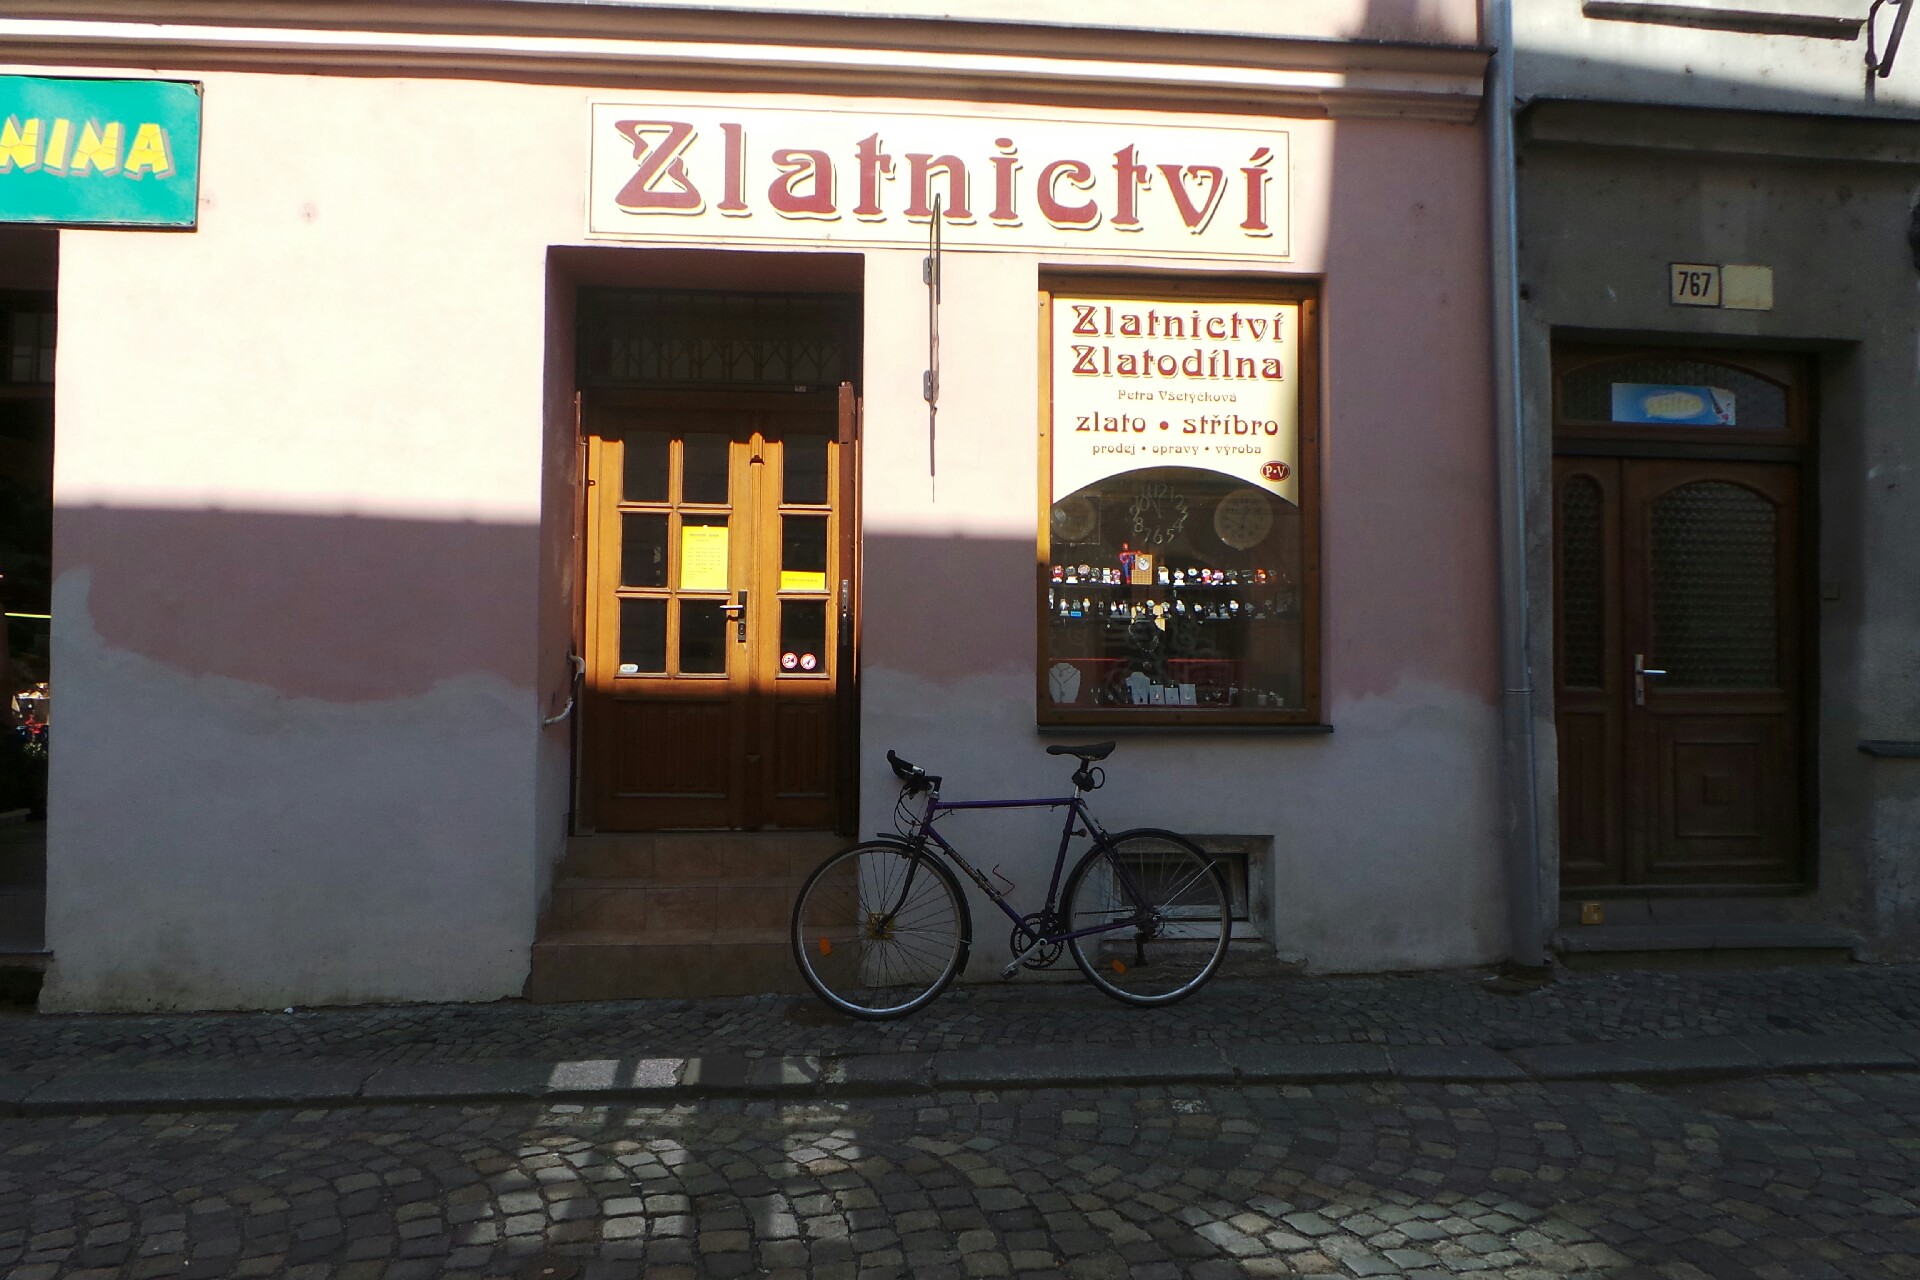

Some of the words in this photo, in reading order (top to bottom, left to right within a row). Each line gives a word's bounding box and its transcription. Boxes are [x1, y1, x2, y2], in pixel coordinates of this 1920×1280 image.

[0, 113, 176, 181] NINA
[614, 119, 1273, 236] Zlatnictví
[1678, 271, 1711, 297] 767
[1071, 304, 1284, 342] Zlatnictví
[1071, 344, 1284, 382] Zlatodílna
[1118, 389, 1154, 401] Petra
[1075, 411, 1146, 433] zlato
[1182, 414, 1279, 436] stříbro
[1092, 443, 1136, 456] prodej
[1152, 445, 1199, 456] opravy
[1215, 443, 1262, 455] výroba
